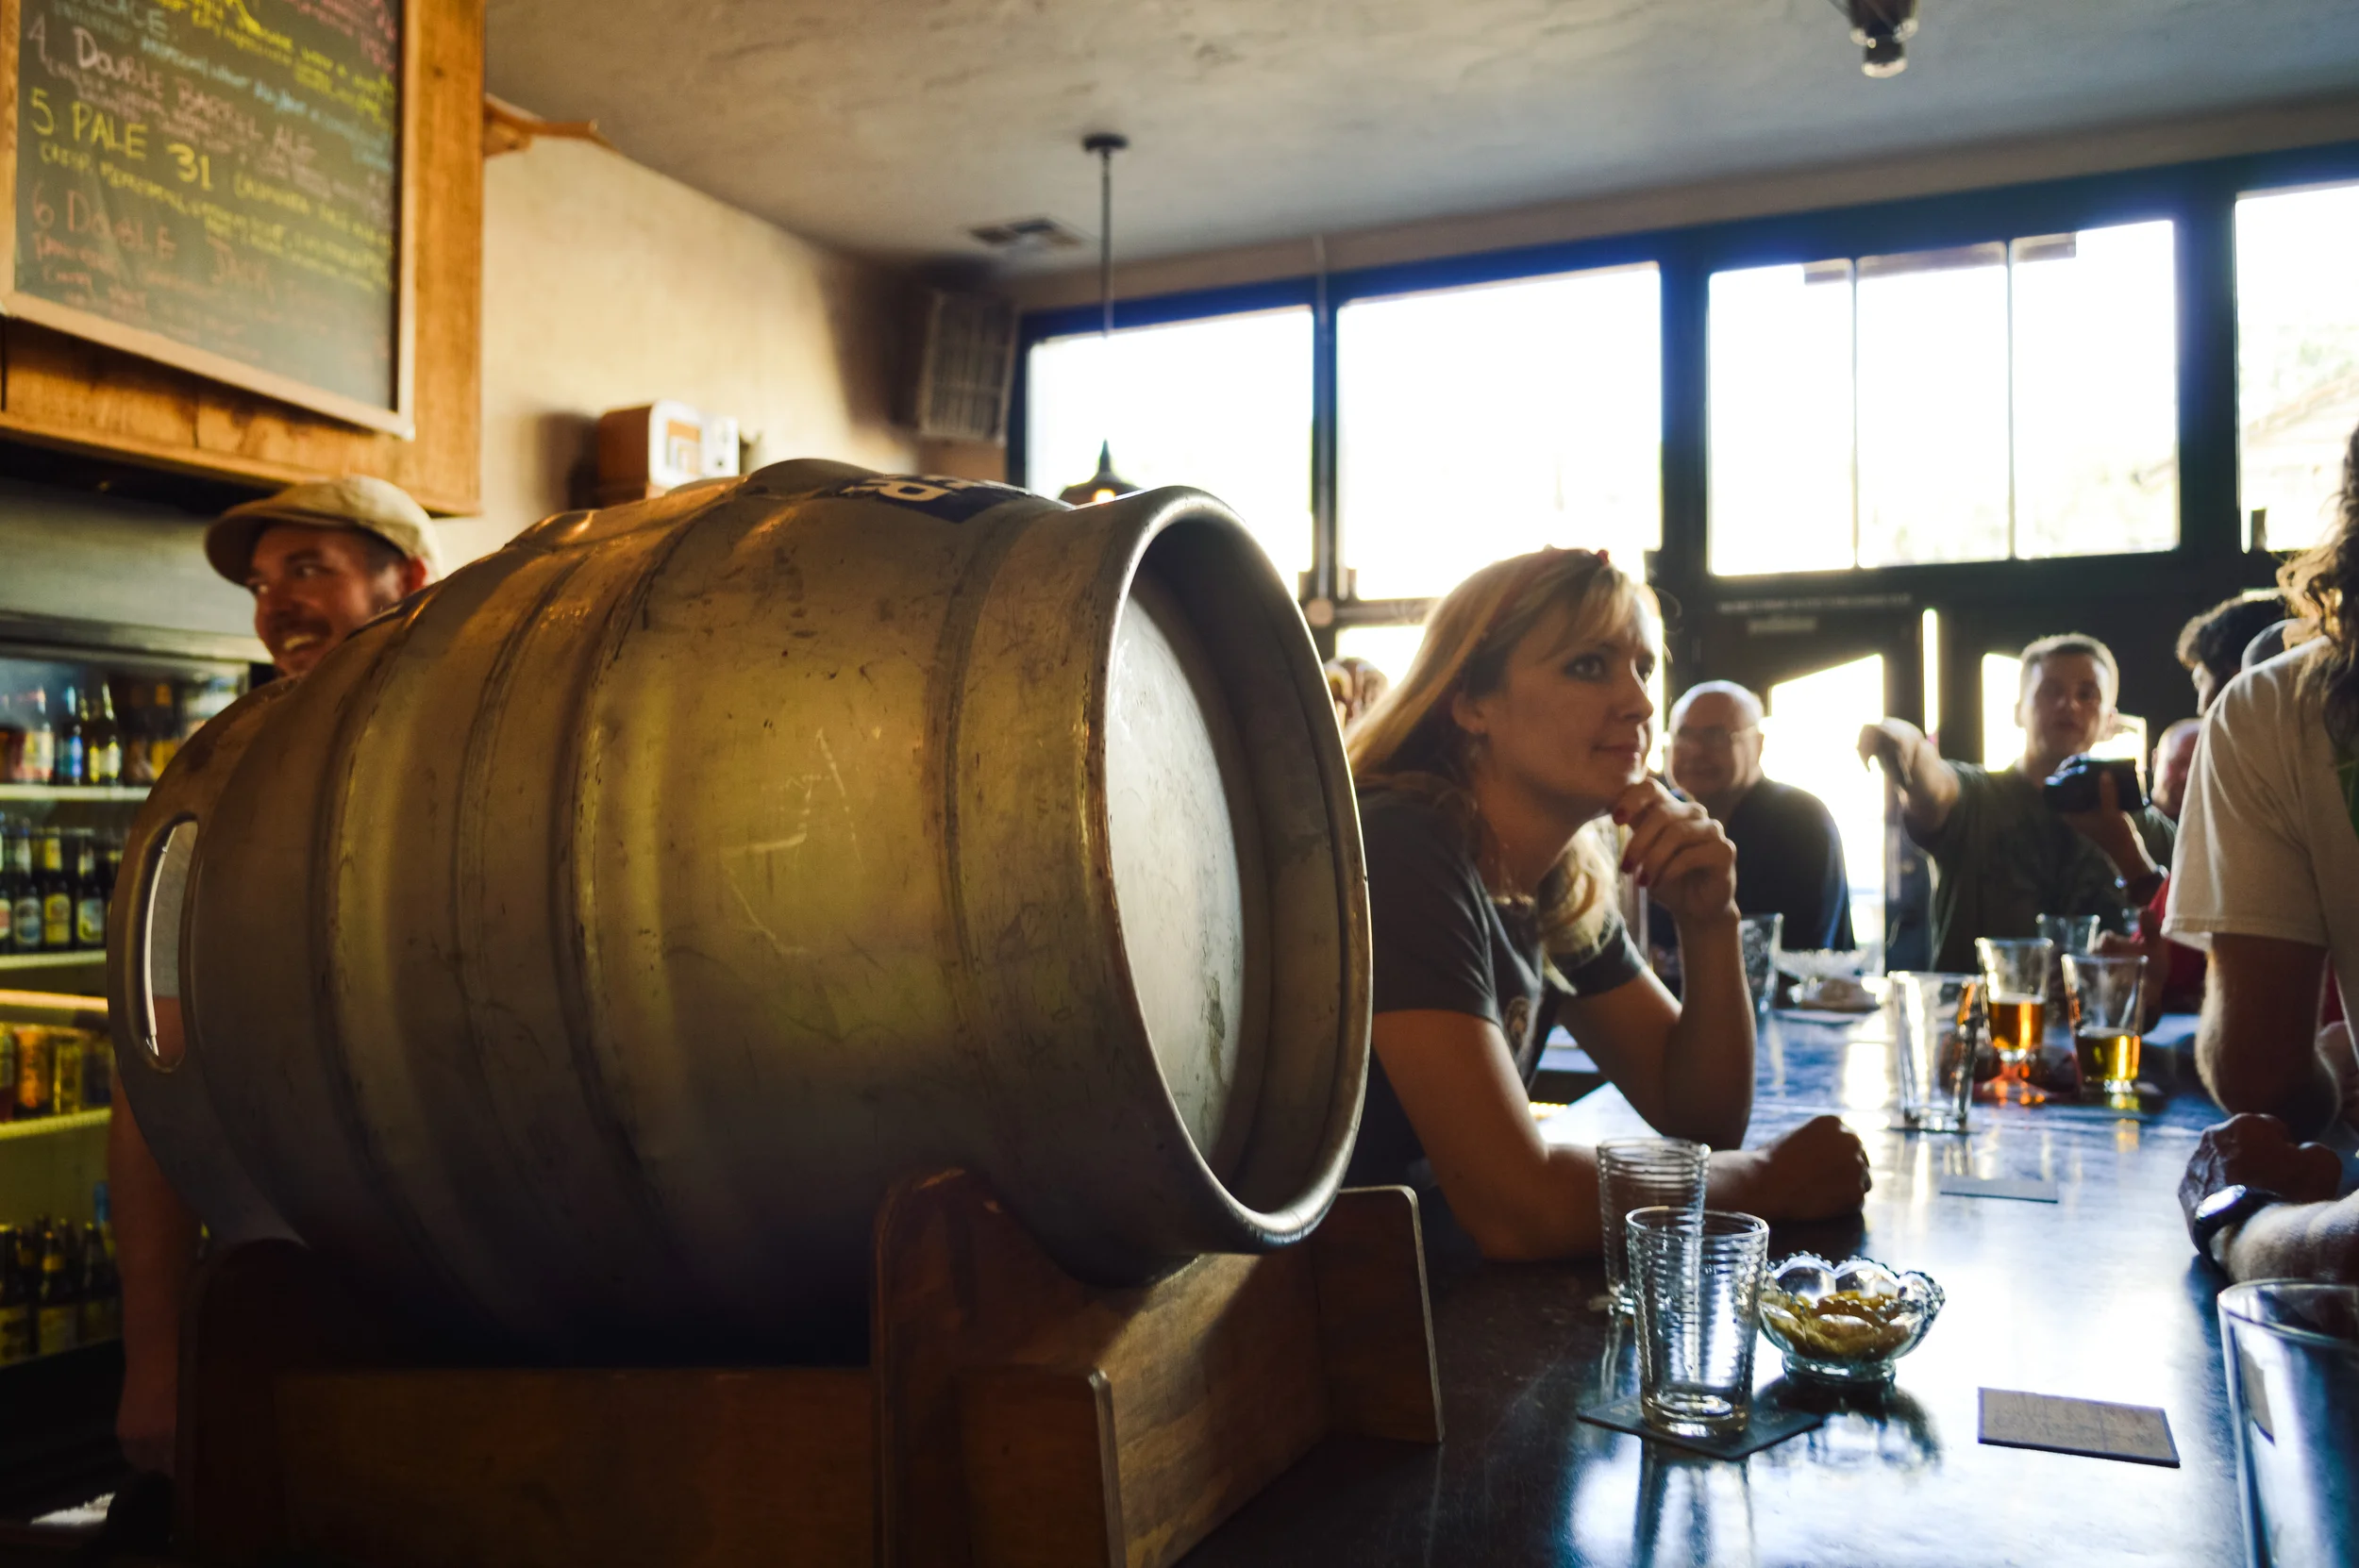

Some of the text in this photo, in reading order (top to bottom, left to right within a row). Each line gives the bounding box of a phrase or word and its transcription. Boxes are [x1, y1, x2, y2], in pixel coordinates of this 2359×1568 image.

[30, 86, 55, 136] 5
[72, 101, 149, 161] PALE
[166, 142, 213, 192] 31
